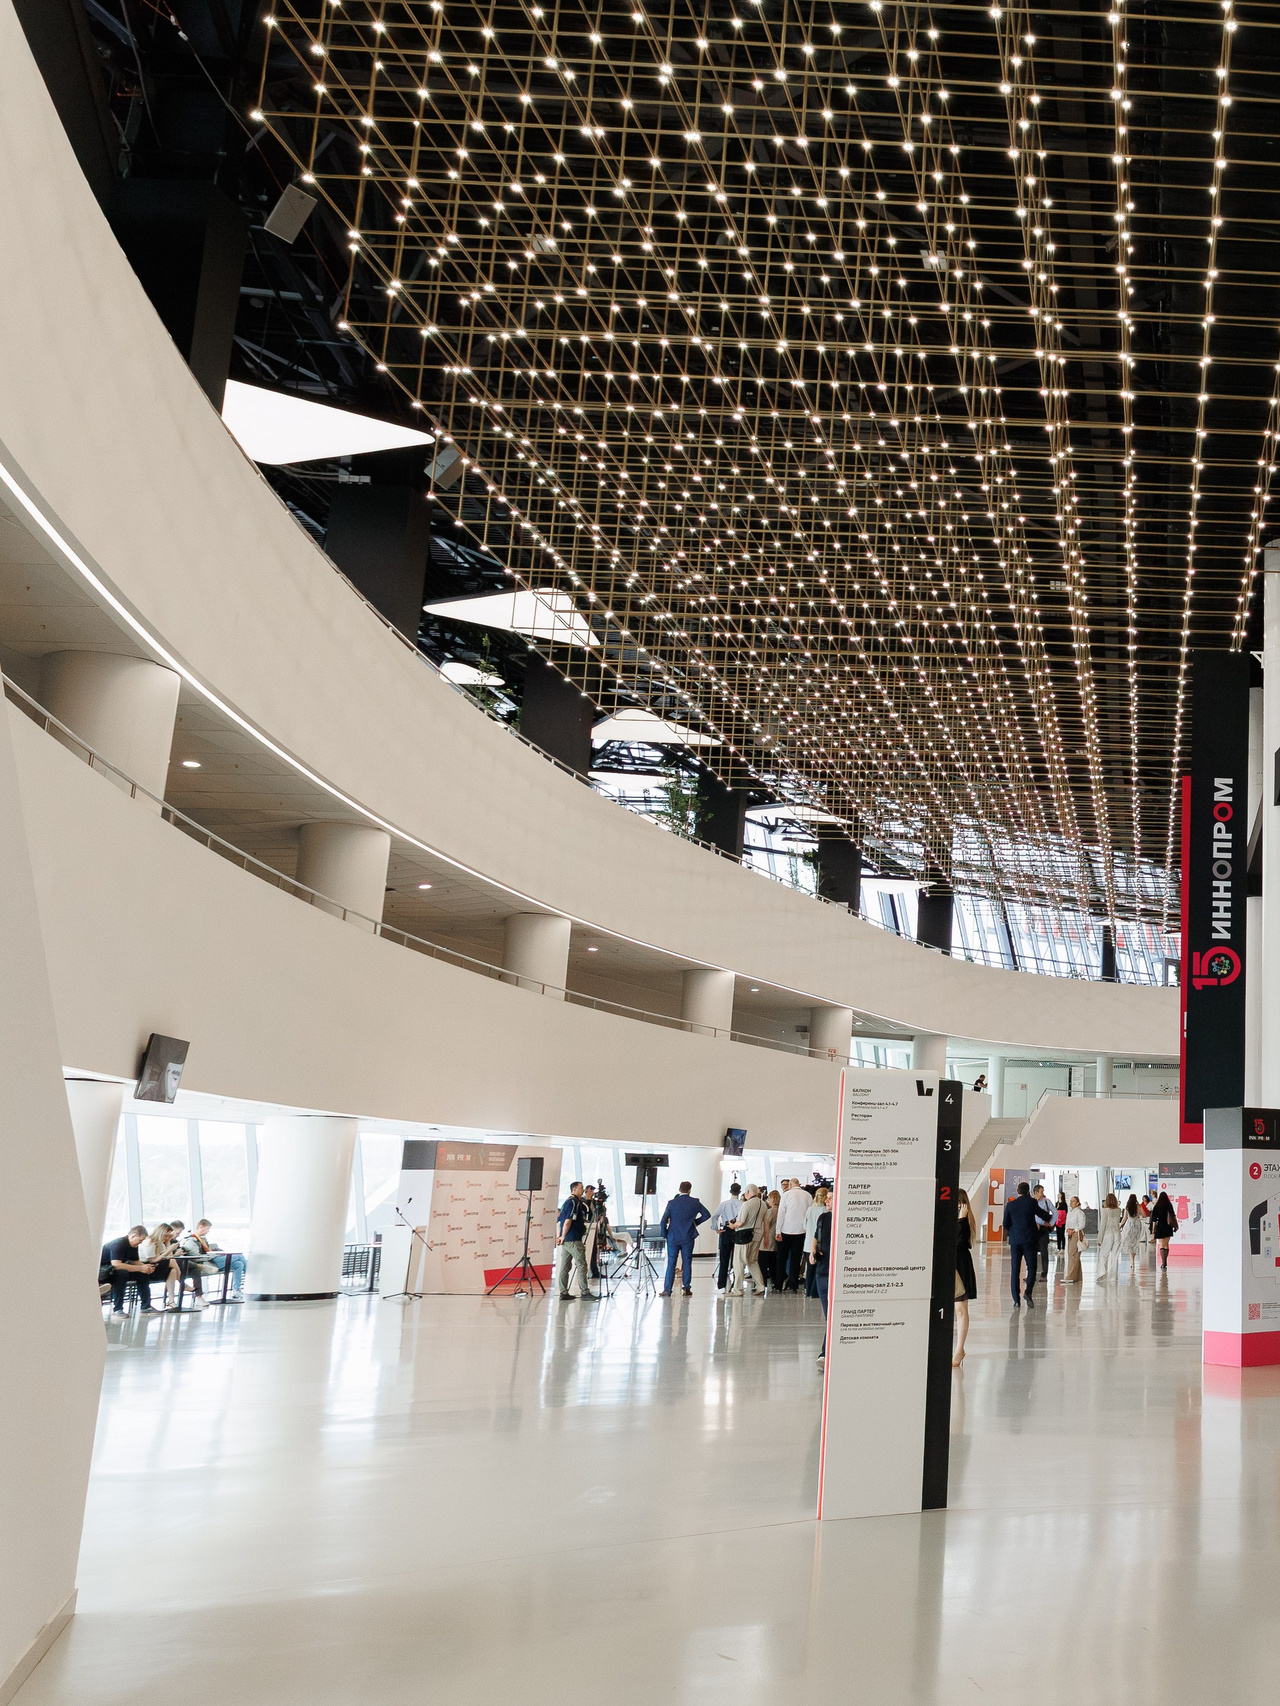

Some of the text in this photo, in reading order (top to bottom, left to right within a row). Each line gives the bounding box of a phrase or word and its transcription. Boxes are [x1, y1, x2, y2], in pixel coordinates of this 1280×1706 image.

[1211, 777, 1233, 940] ИННОПРОМ
[944, 1093, 954, 1105] 4
[943, 1139, 952, 1151] 3
[1252, 1166, 1259, 1176] 2
[940, 1186, 951, 1200] 2
[938, 1307, 944, 1320] 1
